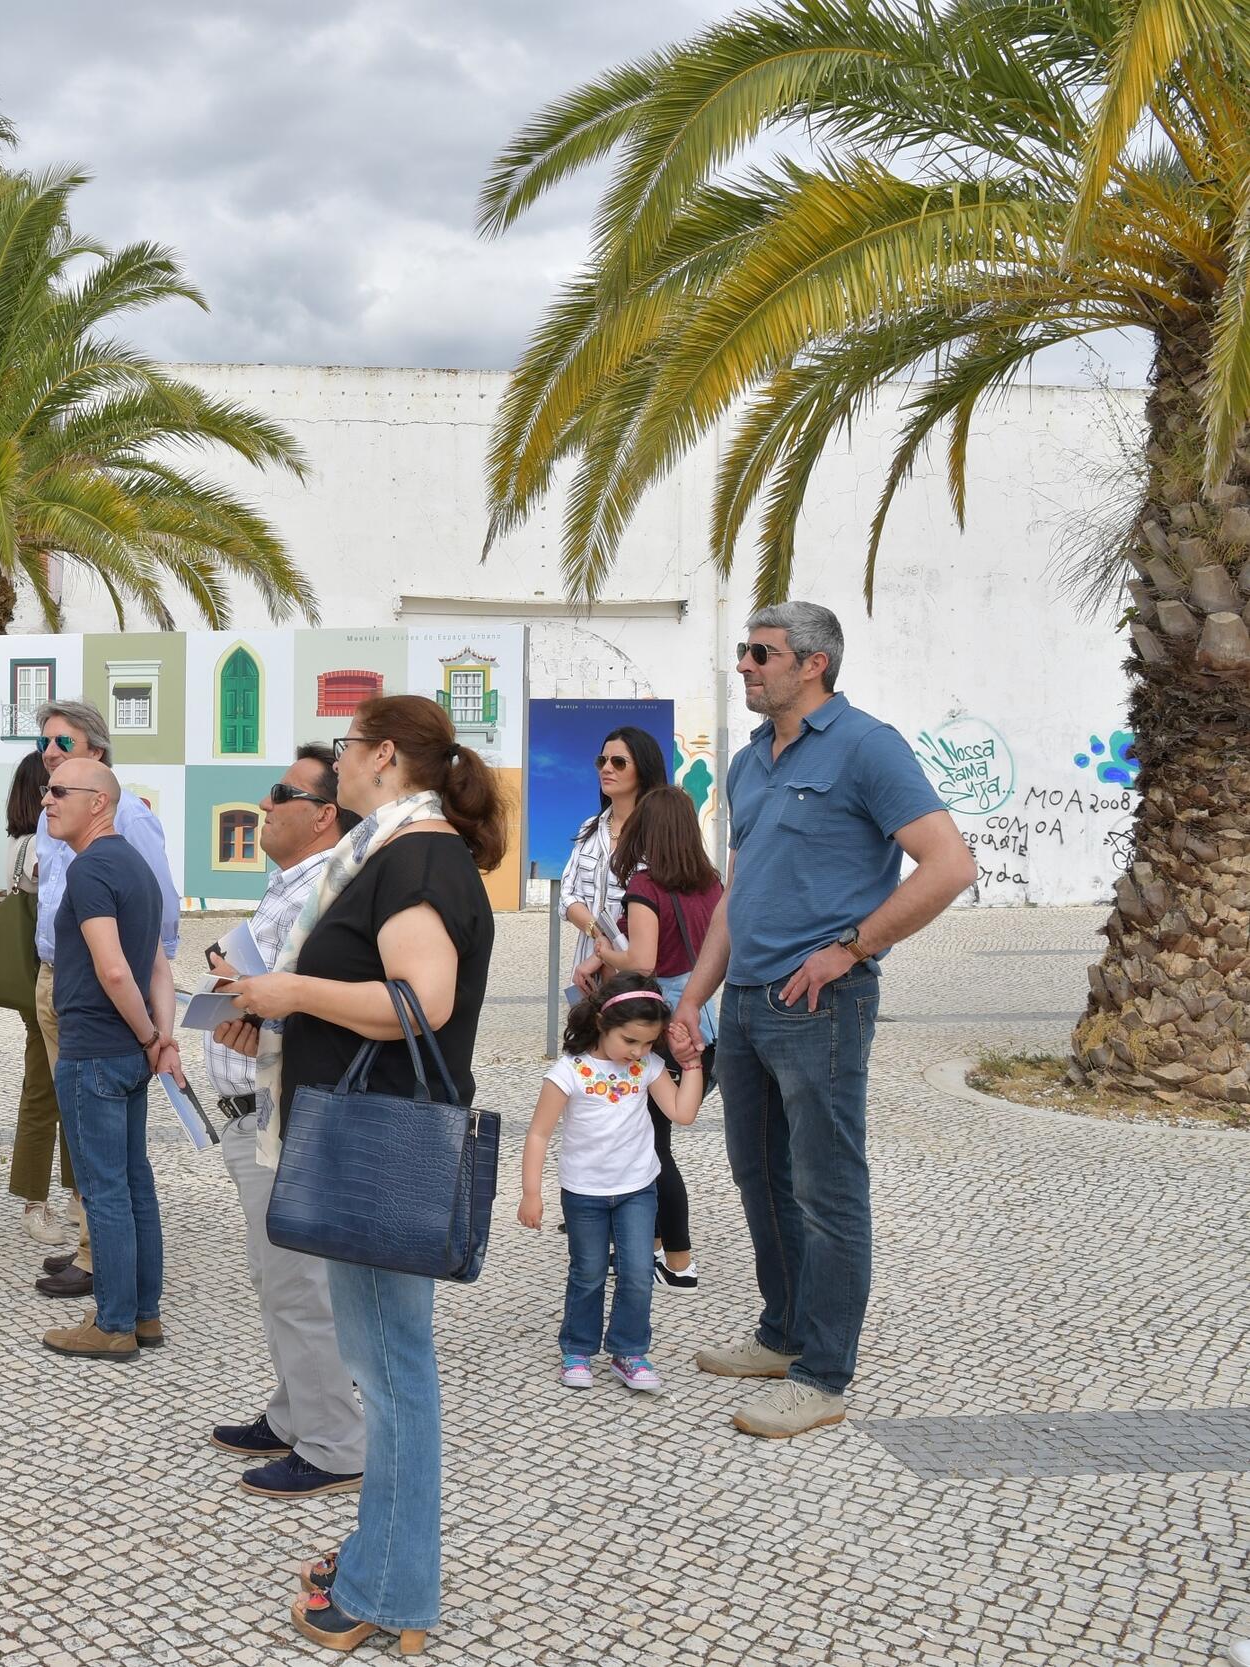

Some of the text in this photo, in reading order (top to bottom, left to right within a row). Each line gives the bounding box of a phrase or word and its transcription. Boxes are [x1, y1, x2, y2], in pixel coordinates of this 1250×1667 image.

[437, 633, 466, 642] Espaço
[938, 738, 995, 765] Nossa
[1024, 787, 1130, 813] MOA 2008
